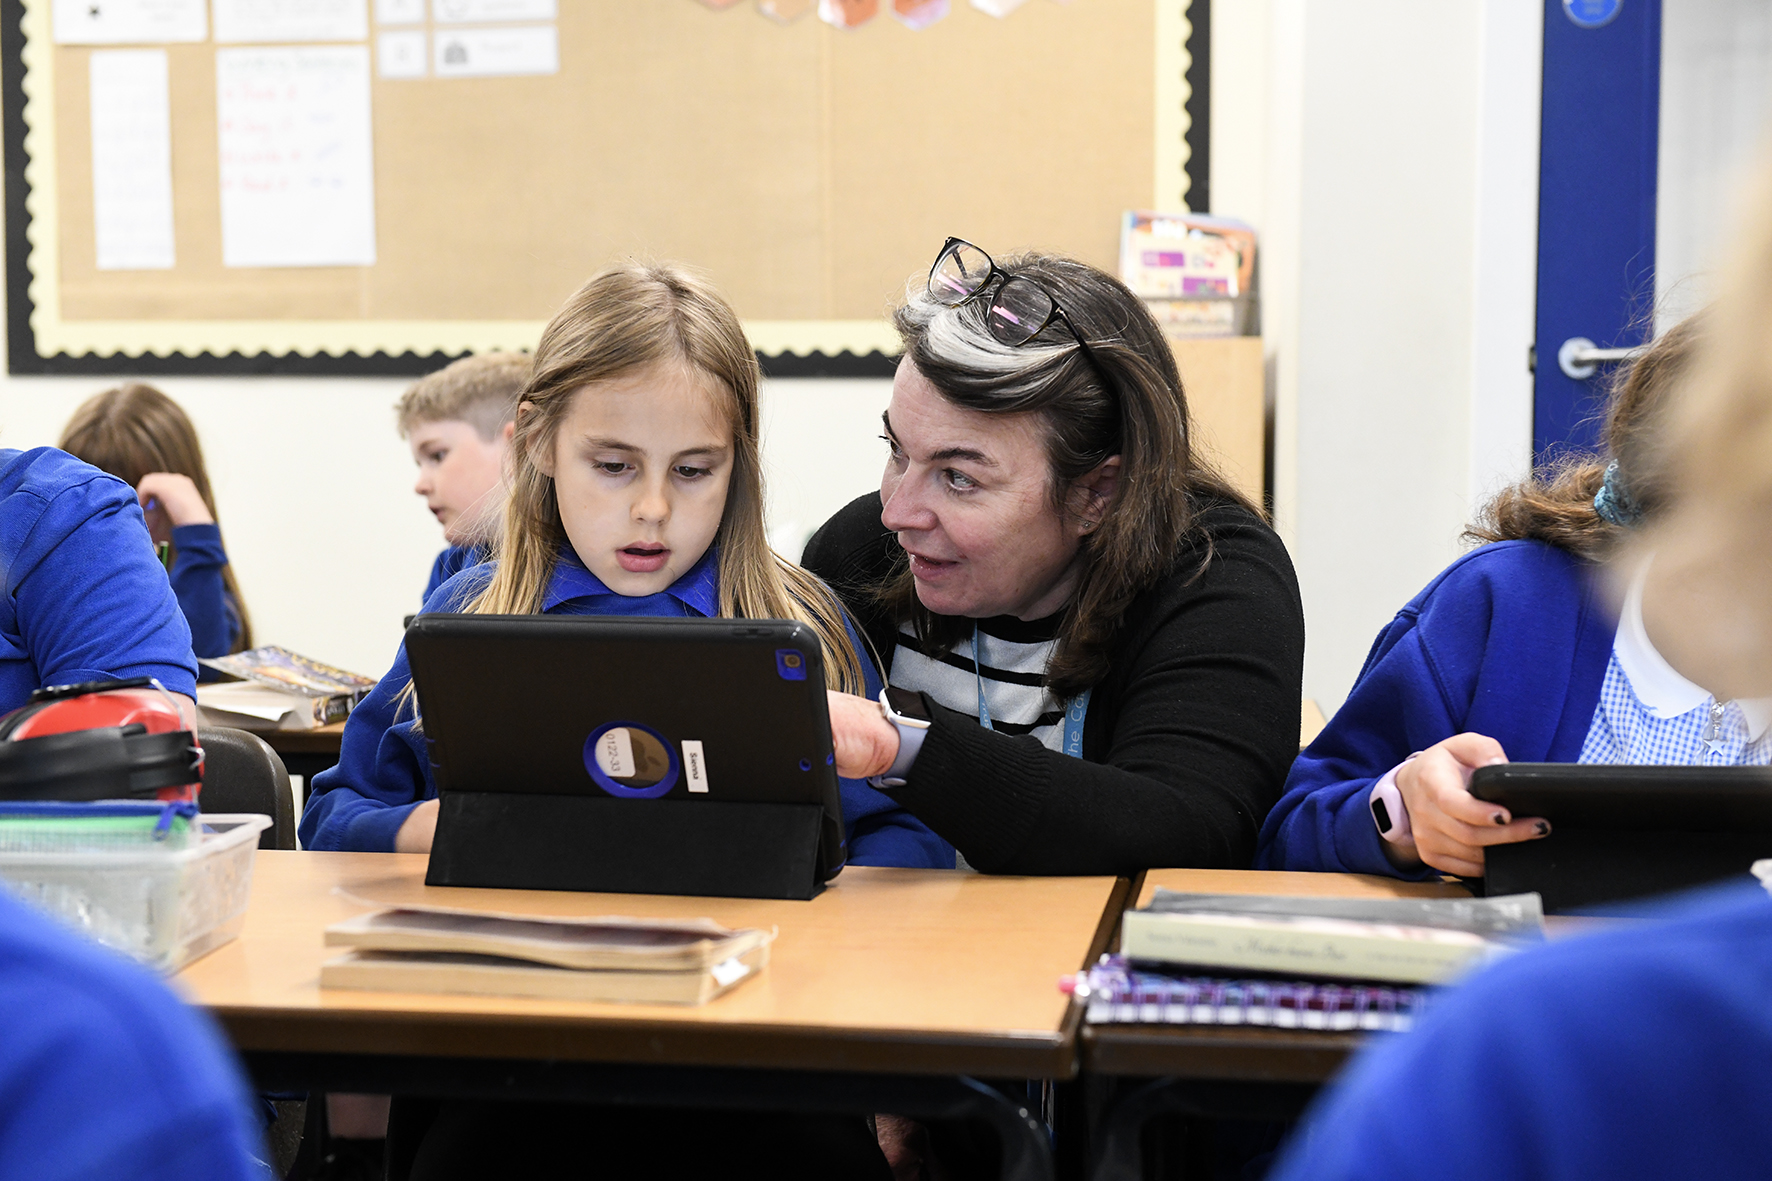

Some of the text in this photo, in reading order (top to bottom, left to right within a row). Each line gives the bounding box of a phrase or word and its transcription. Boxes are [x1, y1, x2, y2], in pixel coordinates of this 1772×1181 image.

[606, 733, 621, 772] 0122-33
[1067, 731, 1080, 756] he
[690, 752, 699, 780] Sienna
